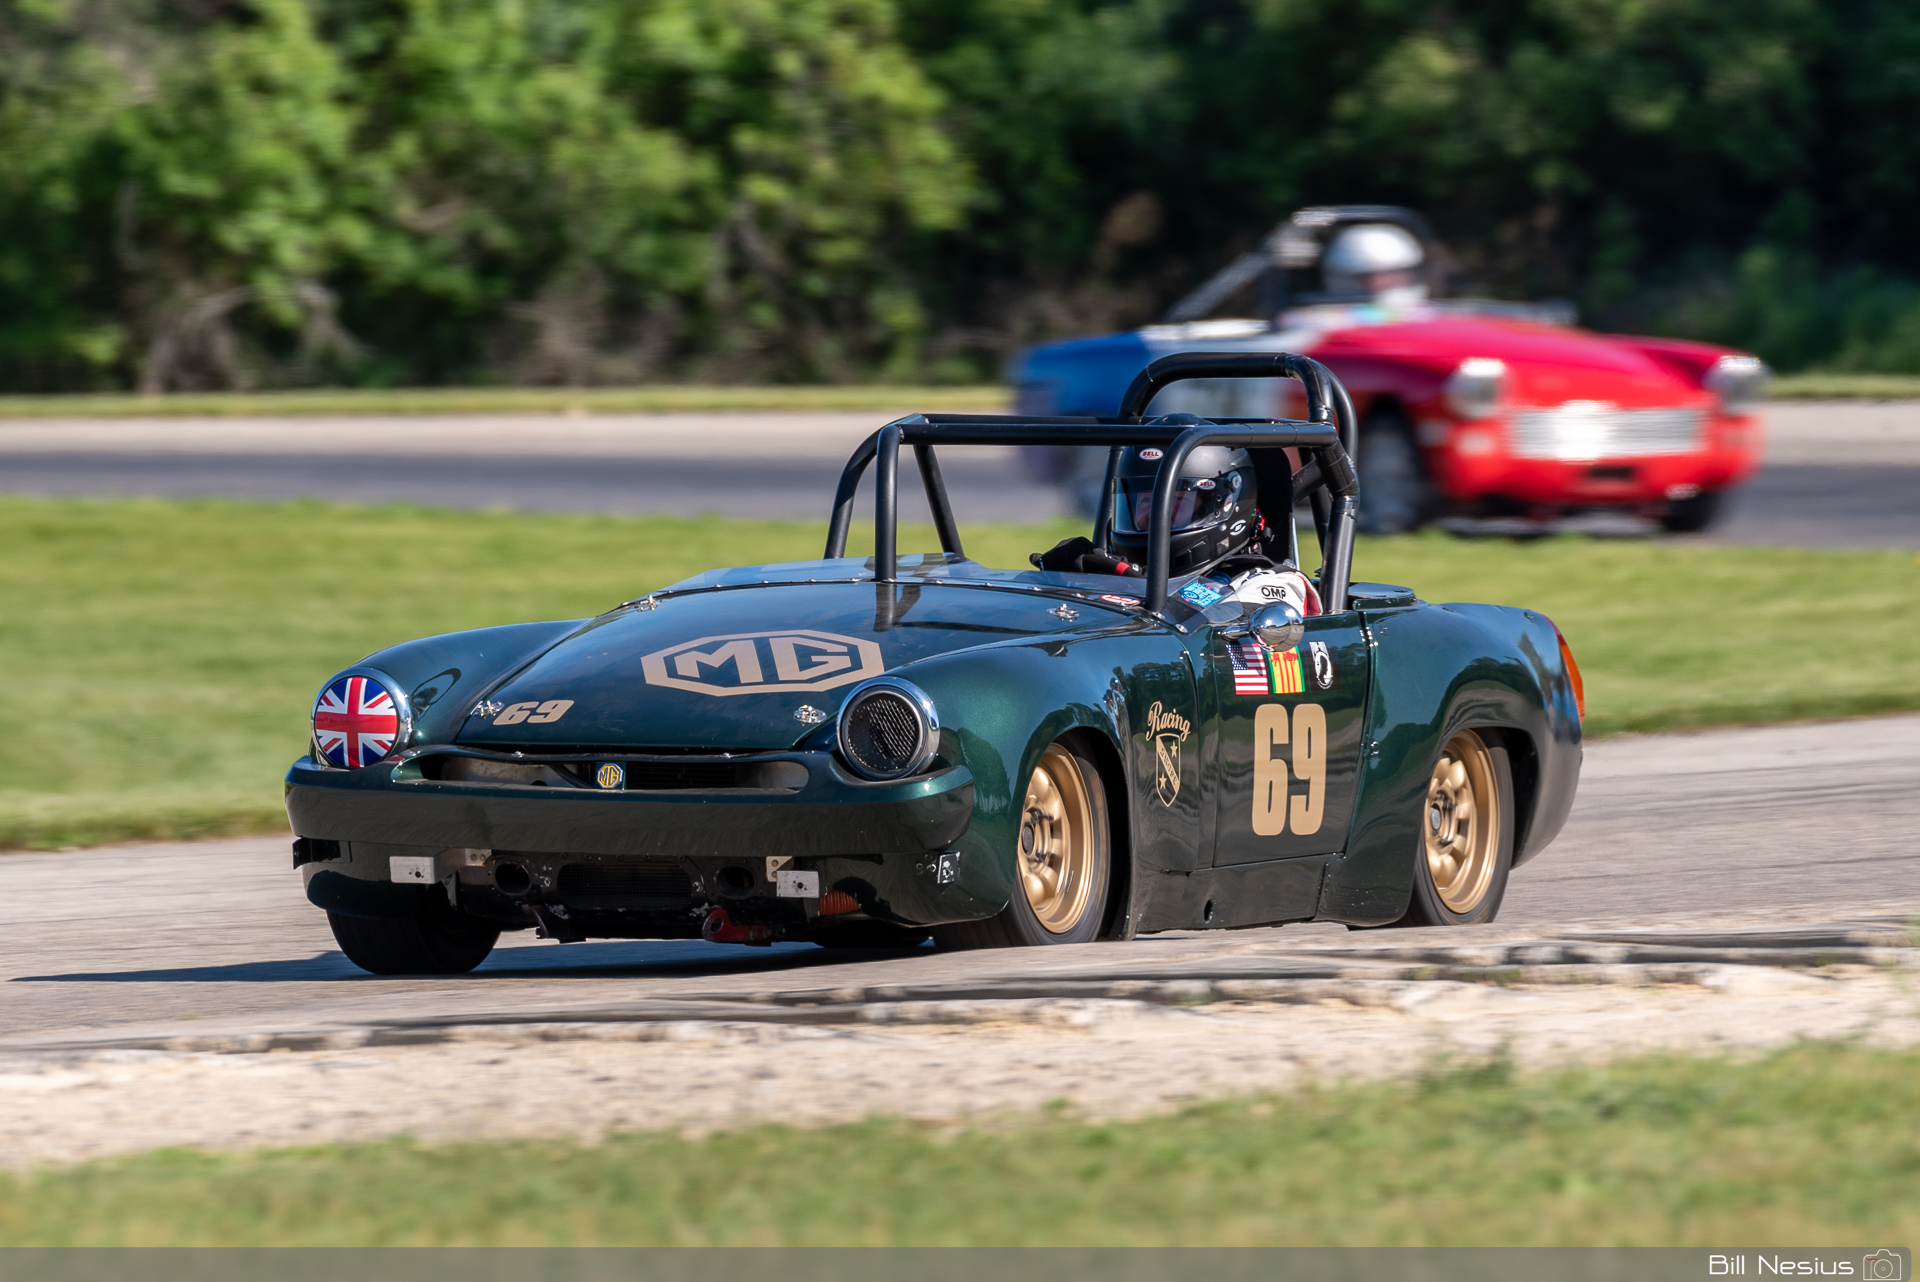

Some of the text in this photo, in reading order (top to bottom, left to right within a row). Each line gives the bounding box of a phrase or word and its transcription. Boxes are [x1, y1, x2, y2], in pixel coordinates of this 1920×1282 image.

[1261, 587, 1286, 599] OMP
[673, 636, 853, 684] MG
[493, 700, 575, 726] 69
[1145, 701, 1191, 741] Racing
[599, 765, 620, 787] MG
[1252, 703, 1327, 836] 69
